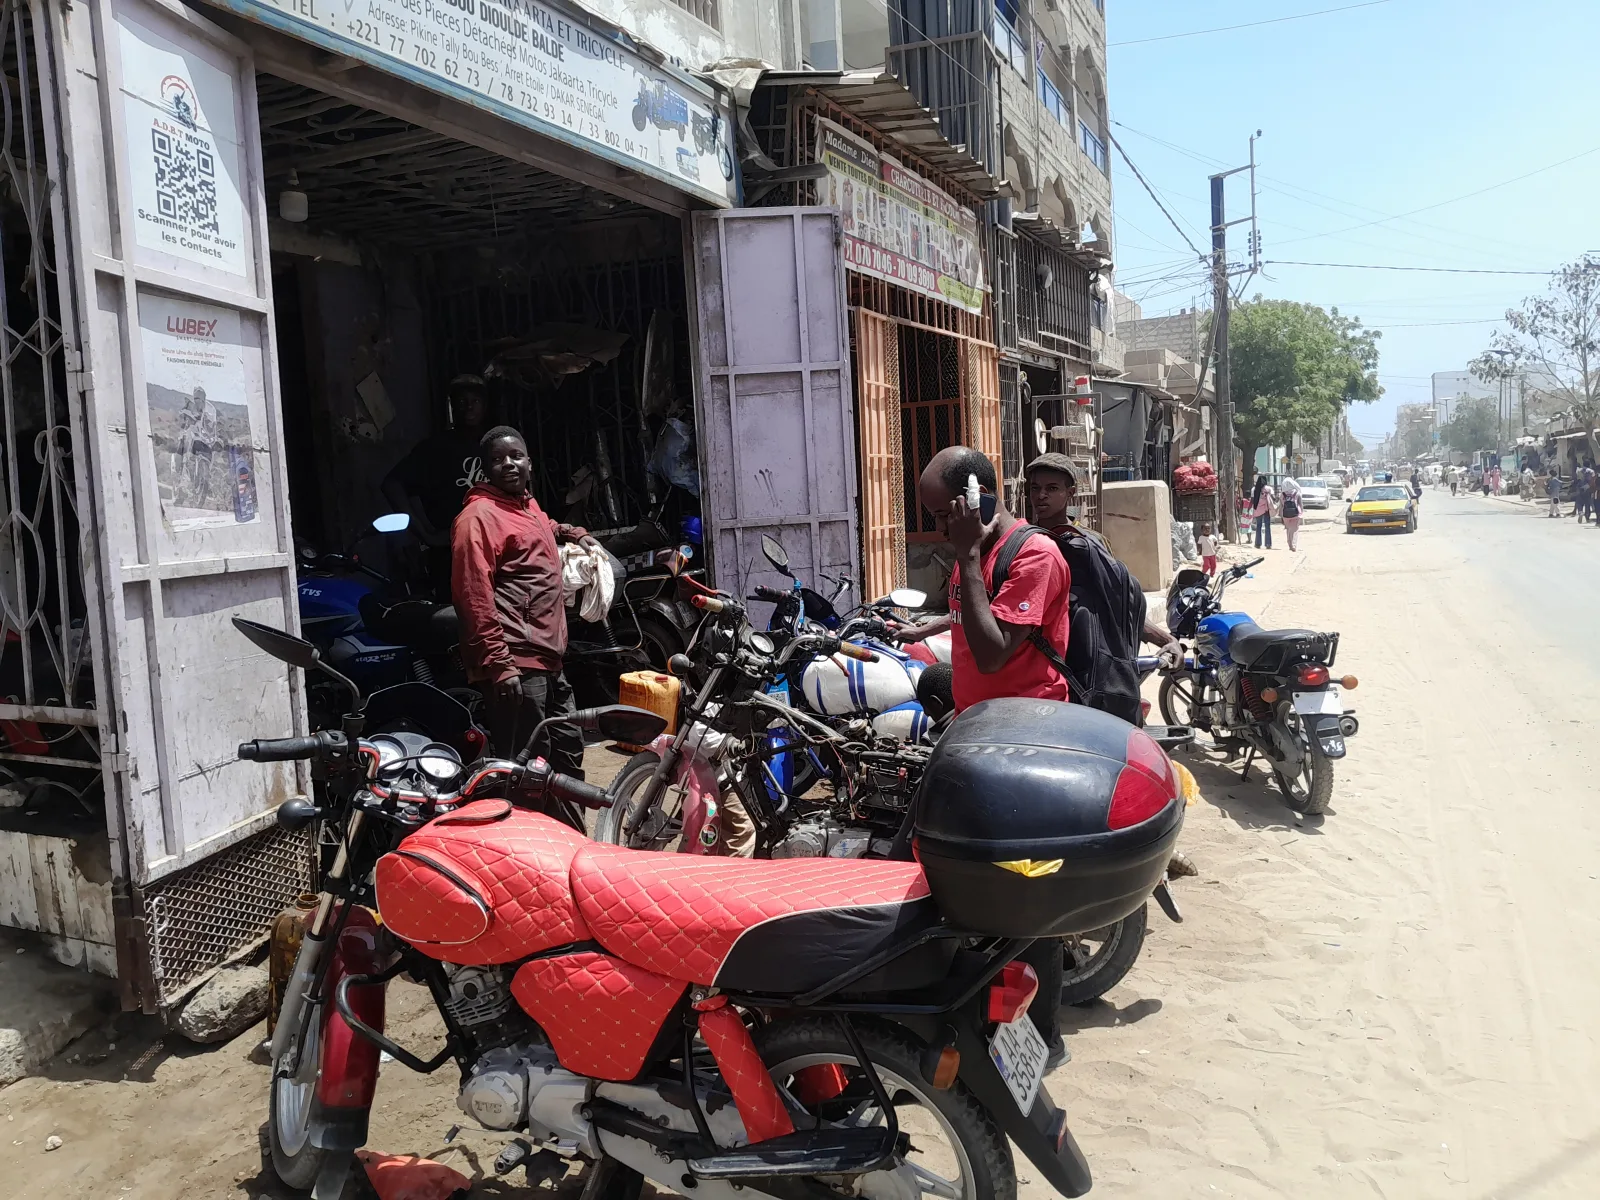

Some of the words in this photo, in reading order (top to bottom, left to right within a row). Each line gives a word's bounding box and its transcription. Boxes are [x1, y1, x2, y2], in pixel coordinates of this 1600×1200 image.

[480, 2, 528, 43] DIOULDE
[532, 29, 564, 62] BALDE
[558, 20, 571, 41] ET
[575, 29, 625, 71] TRICYCLE
[368, 1, 408, 33] Adresse:
[411, 19, 437, 46] Pikine
[440, 33, 460, 60] Tally
[463, 43, 479, 64] Bou
[481, 51, 499, 73] Bess
[505, 62, 524, 85] Arret
[525, 71, 545, 95] Etoile
[551, 84, 575, 110] DAKAR
[576, 97, 606, 123] SENEGAL
[425, 0, 460, 33] Pieces
[463, 18, 516, 60] Détachées
[519, 45, 547, 76] Motos
[549, 62, 587, 97] Jakaarta,
[586, 80, 618, 109] Tricycle
[347, 19, 381, 46] +221
[390, 34, 404, 55] 77
[414, 44, 436, 69] 702
[444, 58, 458, 79] 62
[467, 67, 480, 88] 73
[487, 76, 494, 95] /
[501, 82, 514, 102] 78
[520, 91, 538, 113] 732
[543, 102, 555, 120] 93
[561, 109, 573, 128] 14
[588, 122, 600, 139] 33
[604, 129, 621, 148] 802
[624, 138, 635, 154] 04
[639, 144, 648, 160] 77
[185, 132, 210, 151] MOTO
[825, 130, 857, 159] Madame
[829, 154, 847, 173] VENTE
[847, 164, 867, 184] TOUTES
[161, 230, 178, 244] les
[180, 237, 223, 259] Contacts
[191, 228, 212, 242] pour
[214, 235, 237, 250] avoir
[166, 315, 218, 338] LUBEX
[301, 587, 322, 597] TVS
[474, 1098, 503, 1114] TVS
